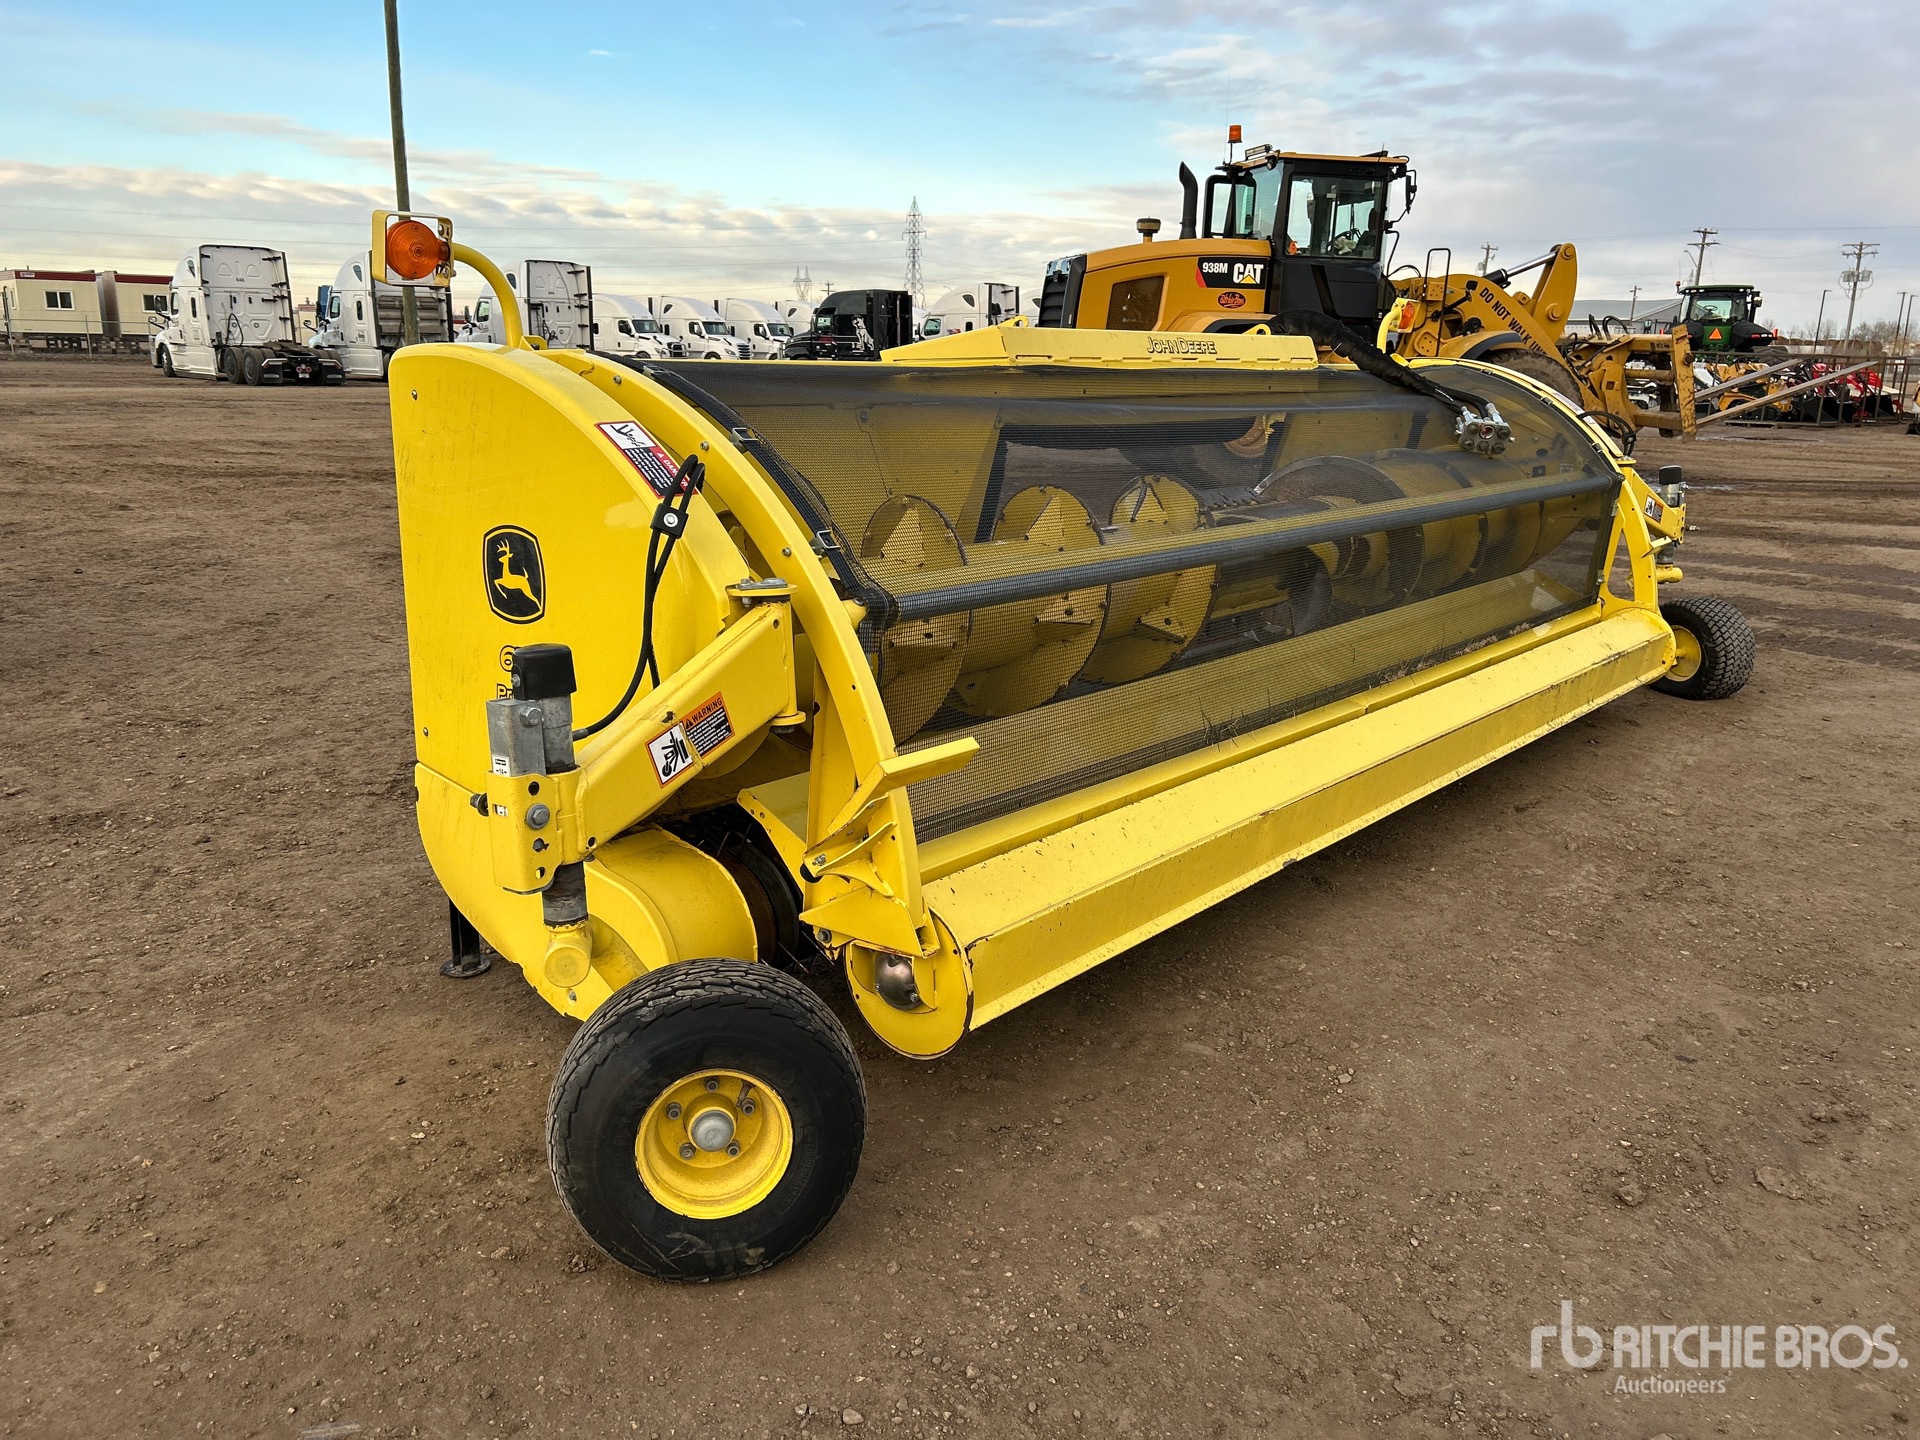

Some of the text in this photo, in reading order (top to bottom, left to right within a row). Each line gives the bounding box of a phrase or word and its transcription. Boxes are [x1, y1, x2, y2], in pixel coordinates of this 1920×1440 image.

[1202, 262, 1264, 285] 938M CAT
[1479, 287, 1547, 355] DO NOT WALK UN
[663, 459, 689, 487] DANR
[496, 683, 514, 700] Pr
[691, 697, 723, 723] WARNING
